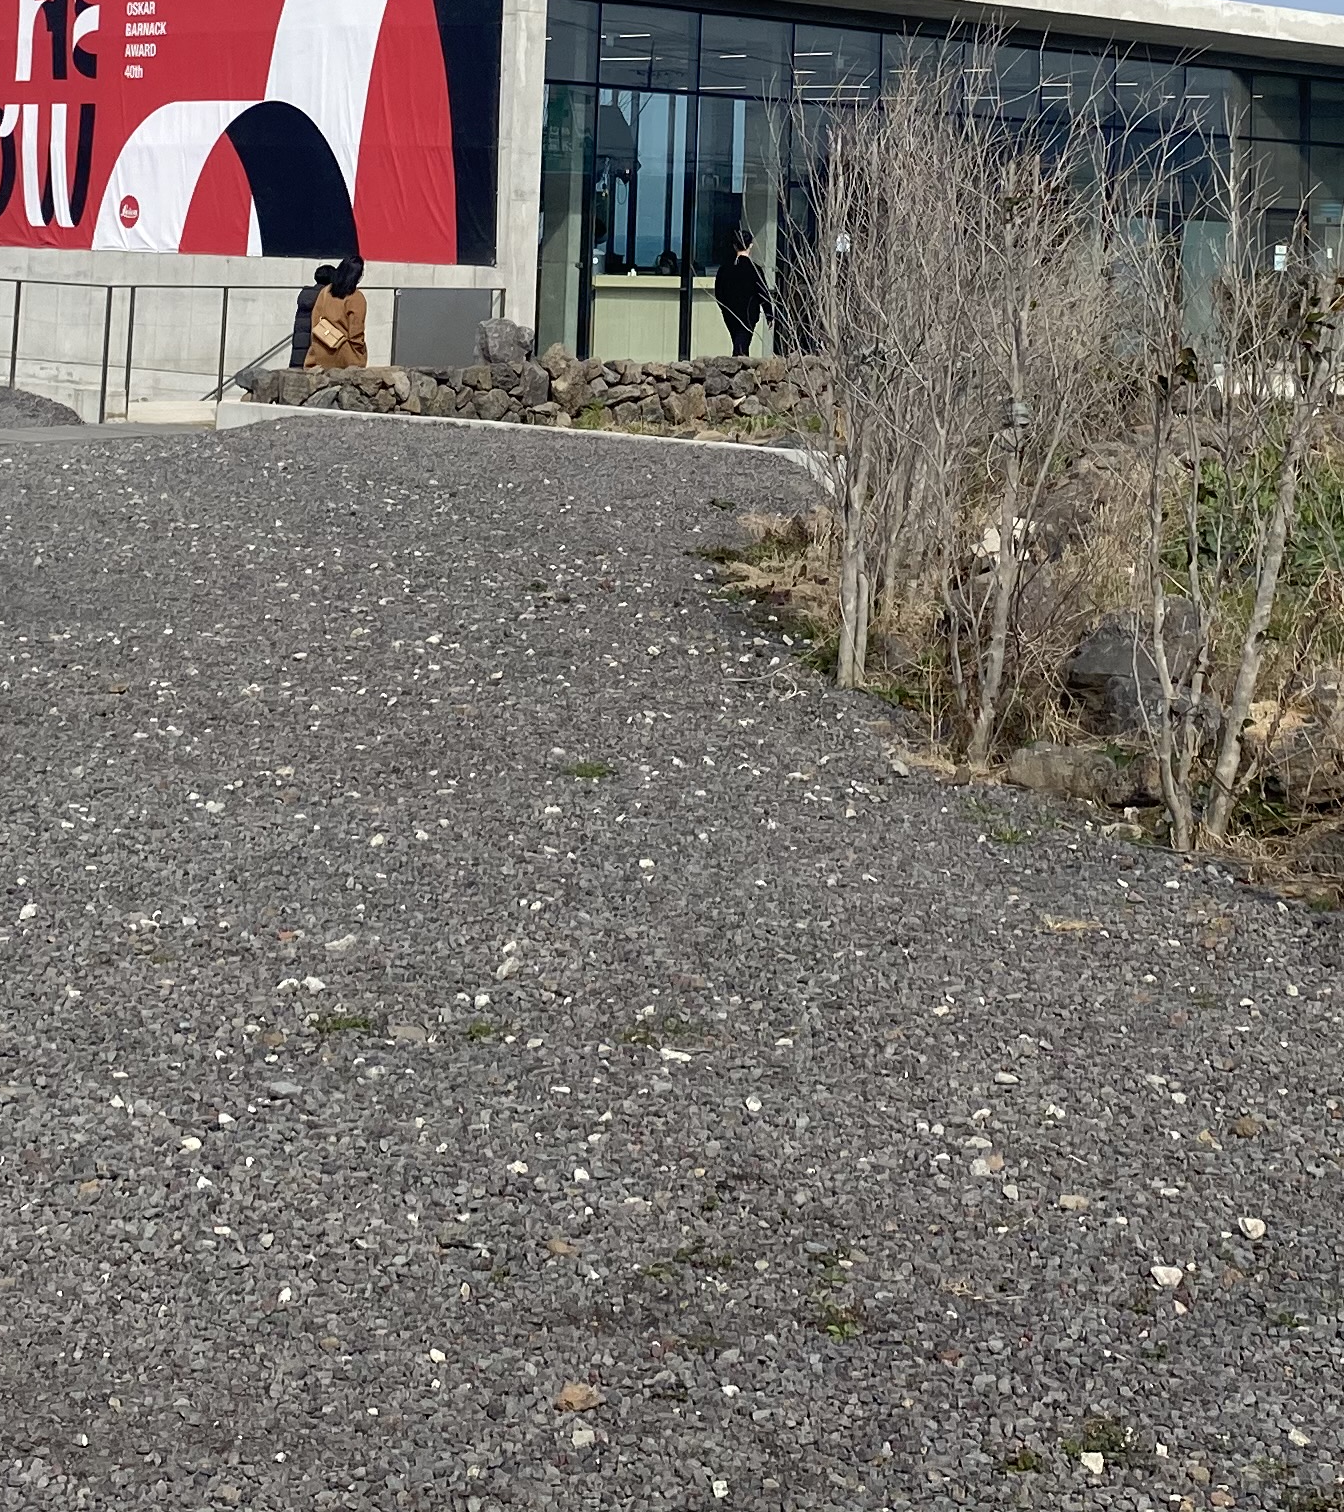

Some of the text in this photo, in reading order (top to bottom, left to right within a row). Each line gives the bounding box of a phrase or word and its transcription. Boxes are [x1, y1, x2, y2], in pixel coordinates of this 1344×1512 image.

[126, 1, 156, 16] OSKAR
[125, 21, 167, 37] BARNACK
[124, 43, 157, 57] AWARD
[124, 64, 144, 79] 40th
